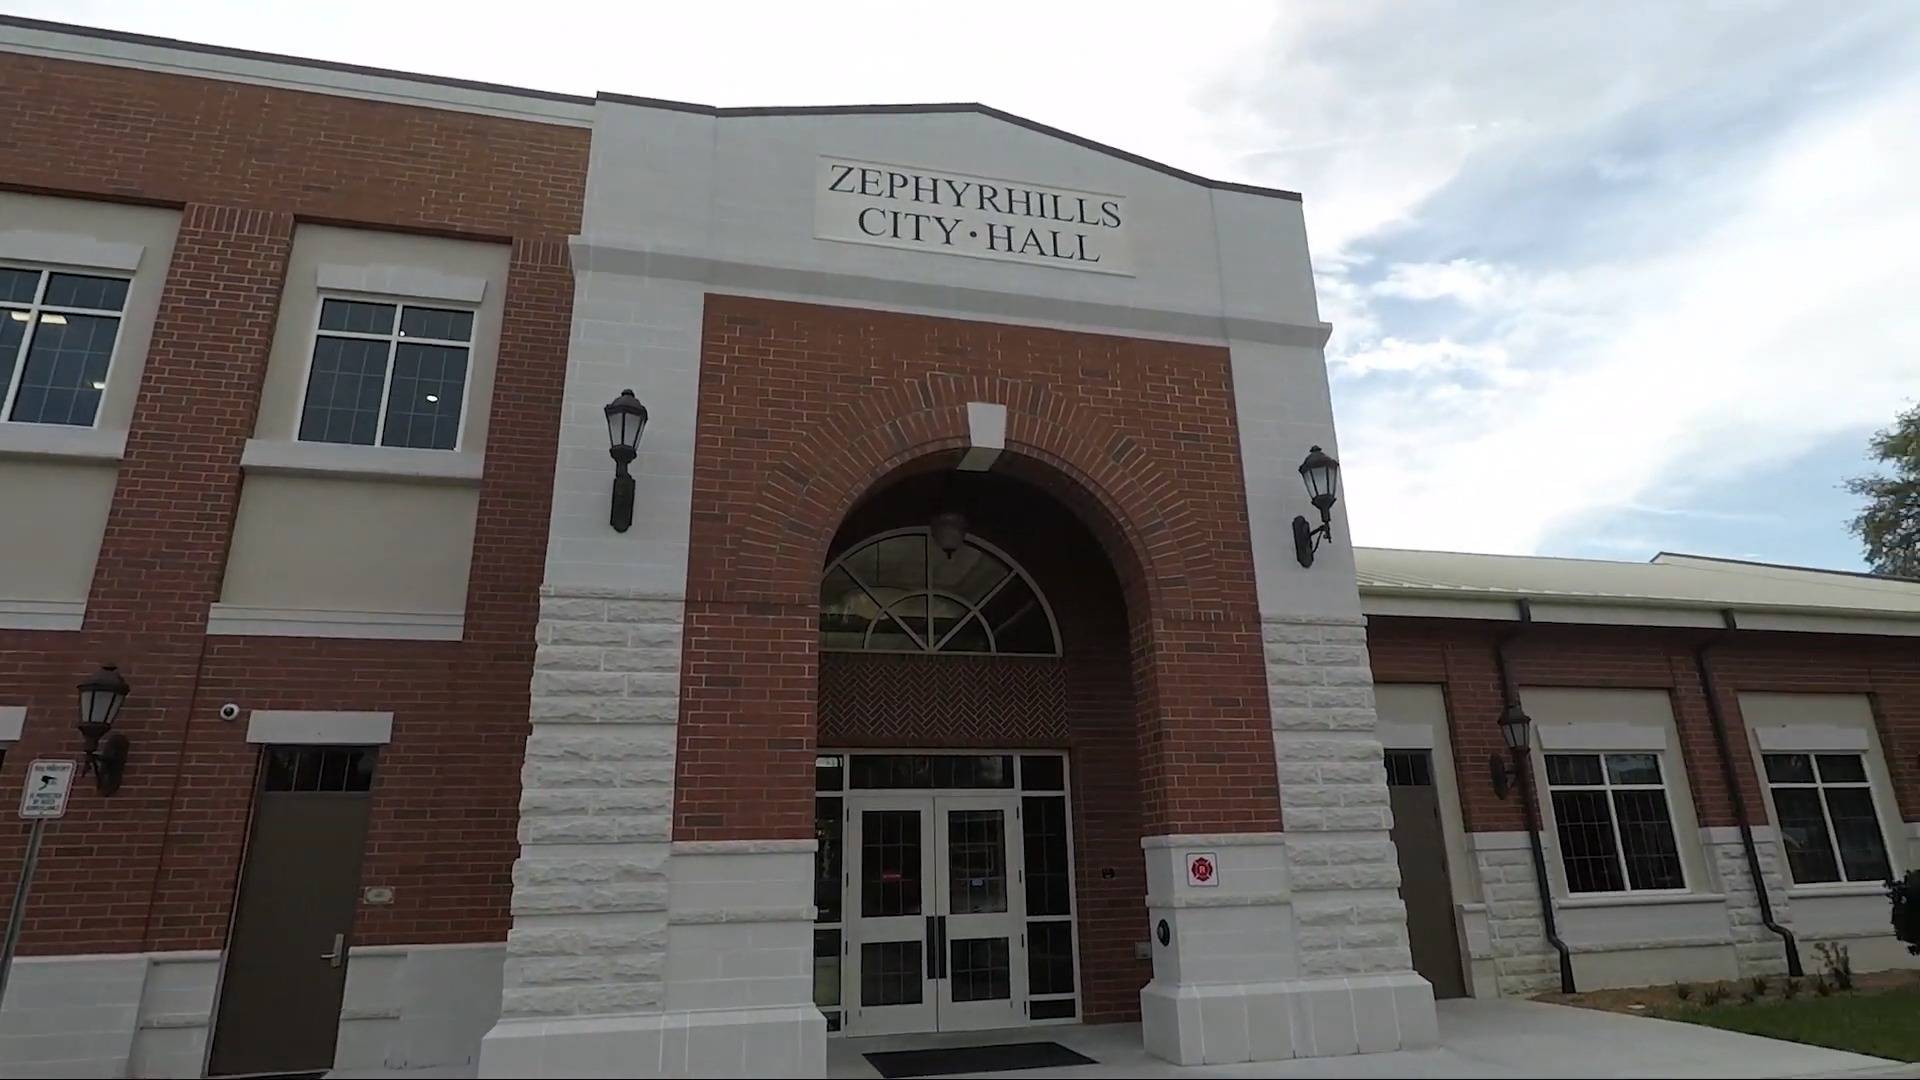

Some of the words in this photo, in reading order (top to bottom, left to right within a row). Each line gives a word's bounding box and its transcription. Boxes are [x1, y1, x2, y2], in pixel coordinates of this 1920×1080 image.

[828, 164, 1121, 228] ZEPHYRHILLS
[858, 207, 963, 246] CITY
[986, 223, 1101, 263] HALL
